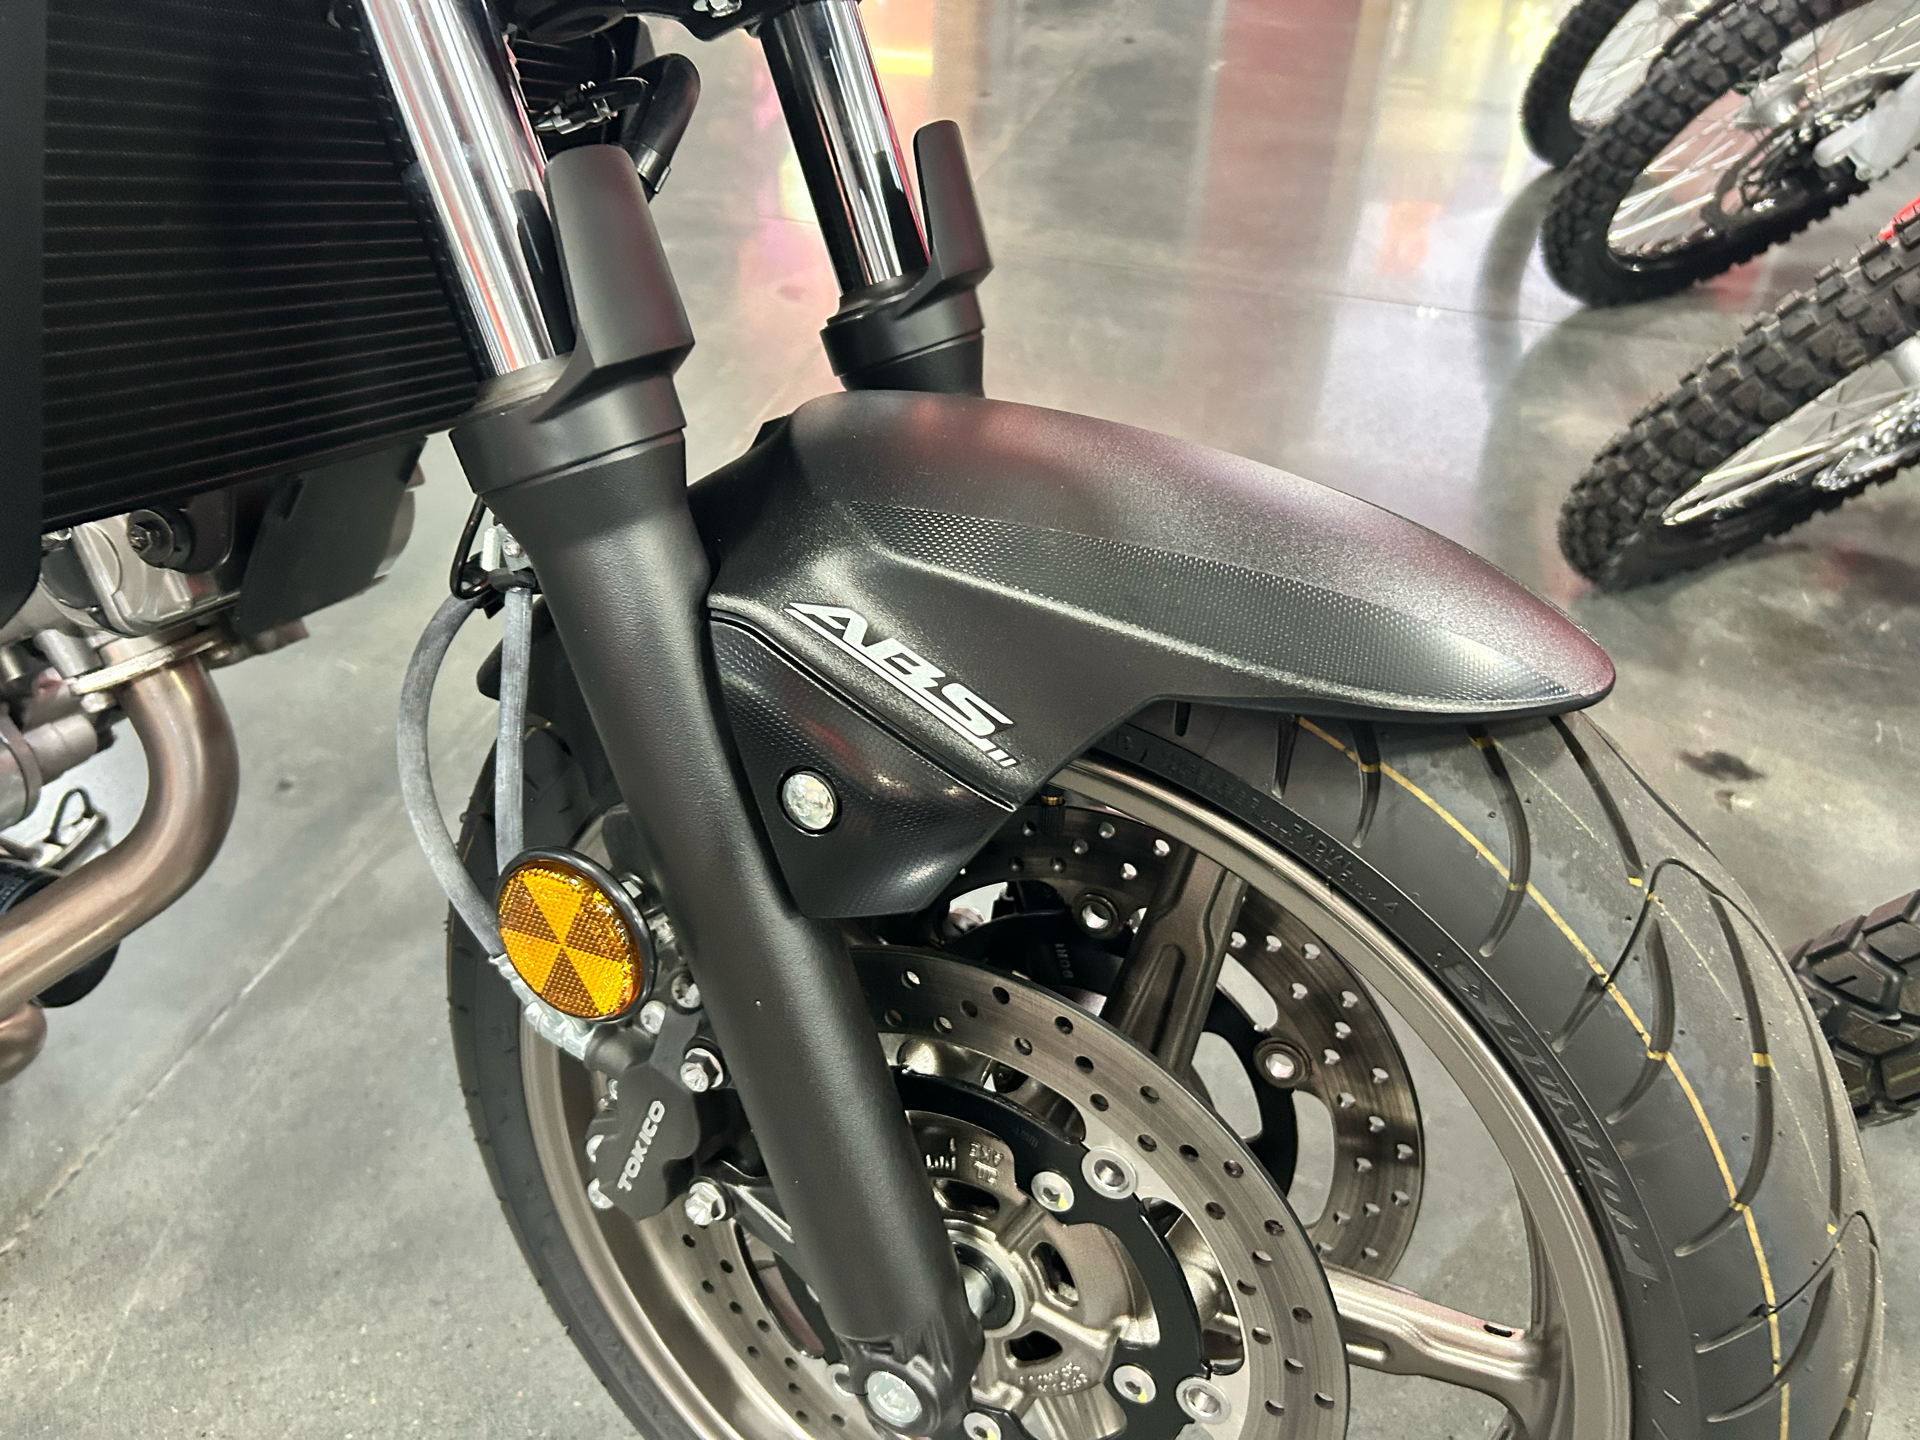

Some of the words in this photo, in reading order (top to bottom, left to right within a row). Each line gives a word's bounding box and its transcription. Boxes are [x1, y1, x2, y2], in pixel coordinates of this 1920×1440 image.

[787, 602, 1016, 740] ABS
[1293, 822, 1354, 874] RADIAL
[617, 1100, 665, 1191] TOKICO
[1494, 1018, 1652, 1268] DUNLOP
